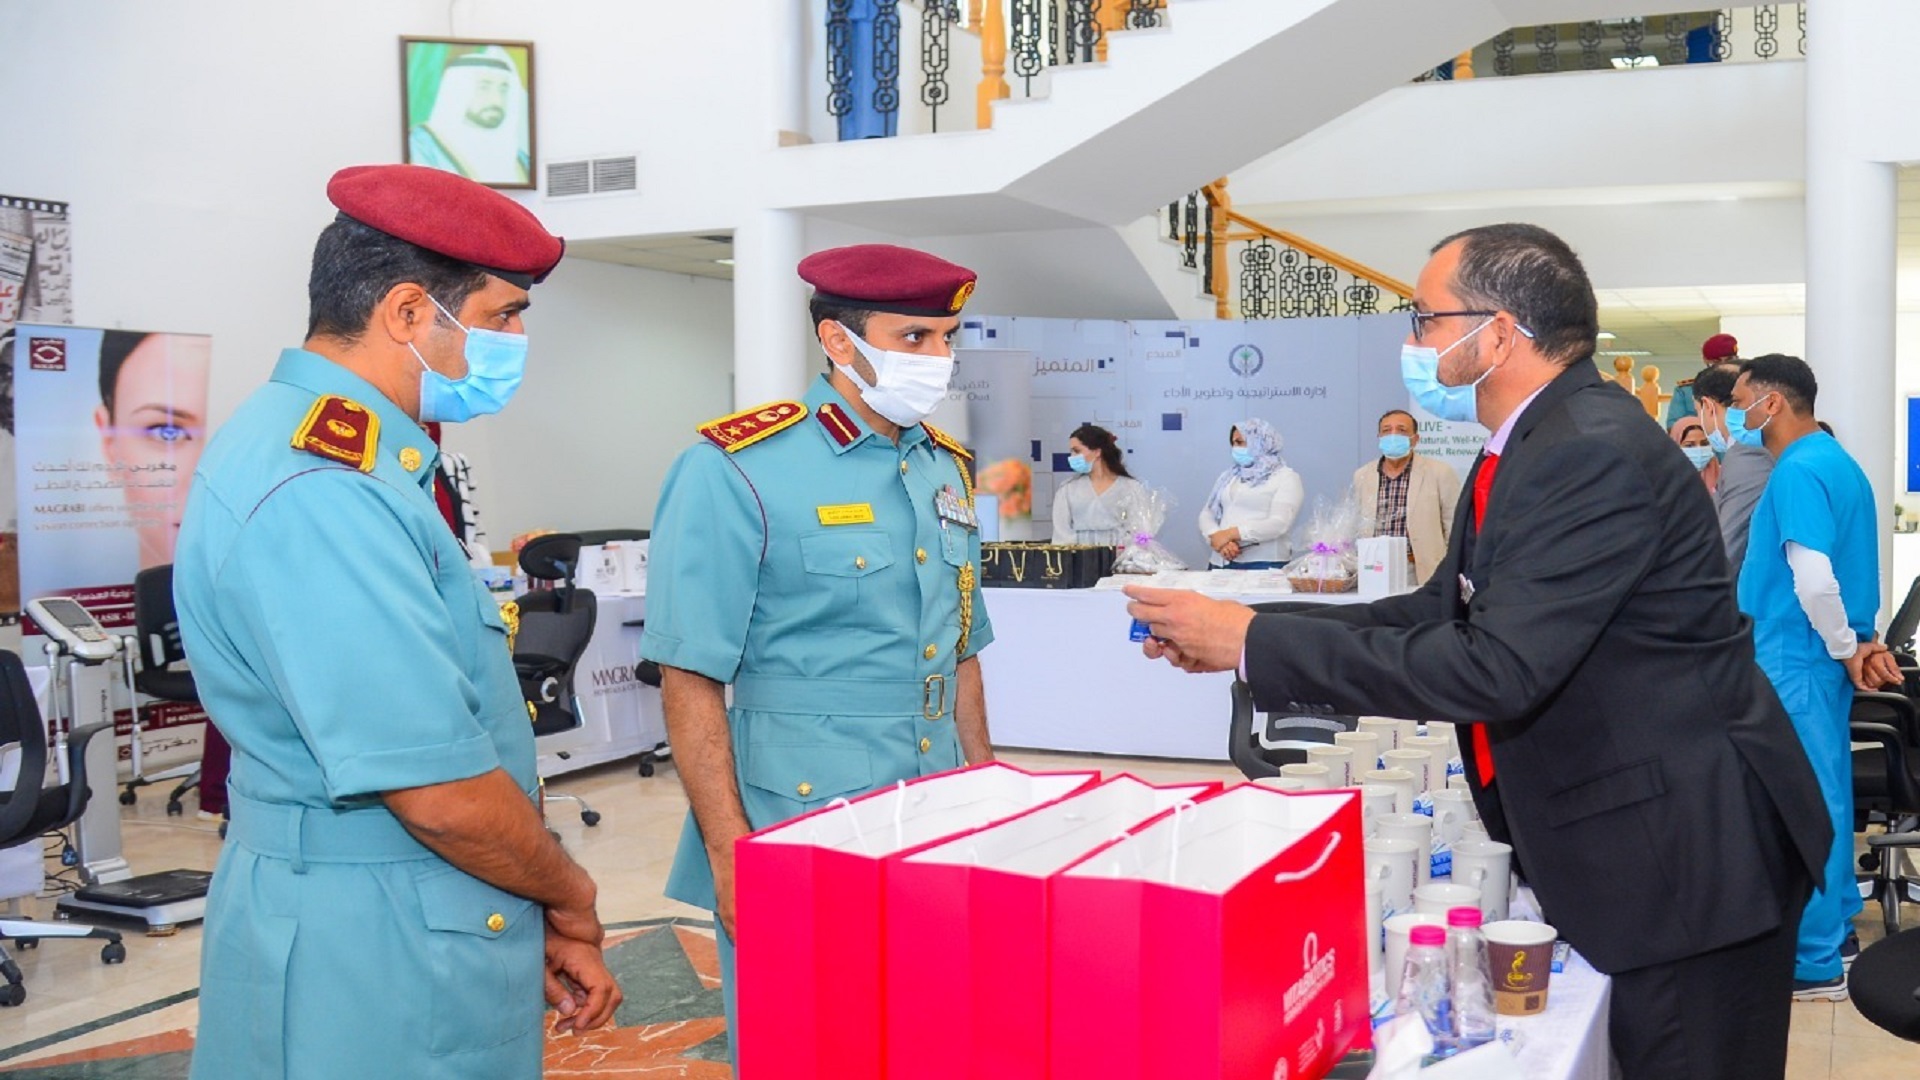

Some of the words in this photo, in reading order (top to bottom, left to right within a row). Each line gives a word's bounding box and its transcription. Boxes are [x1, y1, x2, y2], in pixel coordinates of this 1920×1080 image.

[1032, 356, 1094, 377] المتميز
[1163, 386, 1190, 398] الأداء
[1193, 387, 1233, 400] وتطوير
[1237, 386, 1301, 400] الاستراتيجية
[1304, 386, 1326, 399] إدارة
[1418, 421, 1443, 432] LIVE
[592, 665, 636, 687] MAGRA
